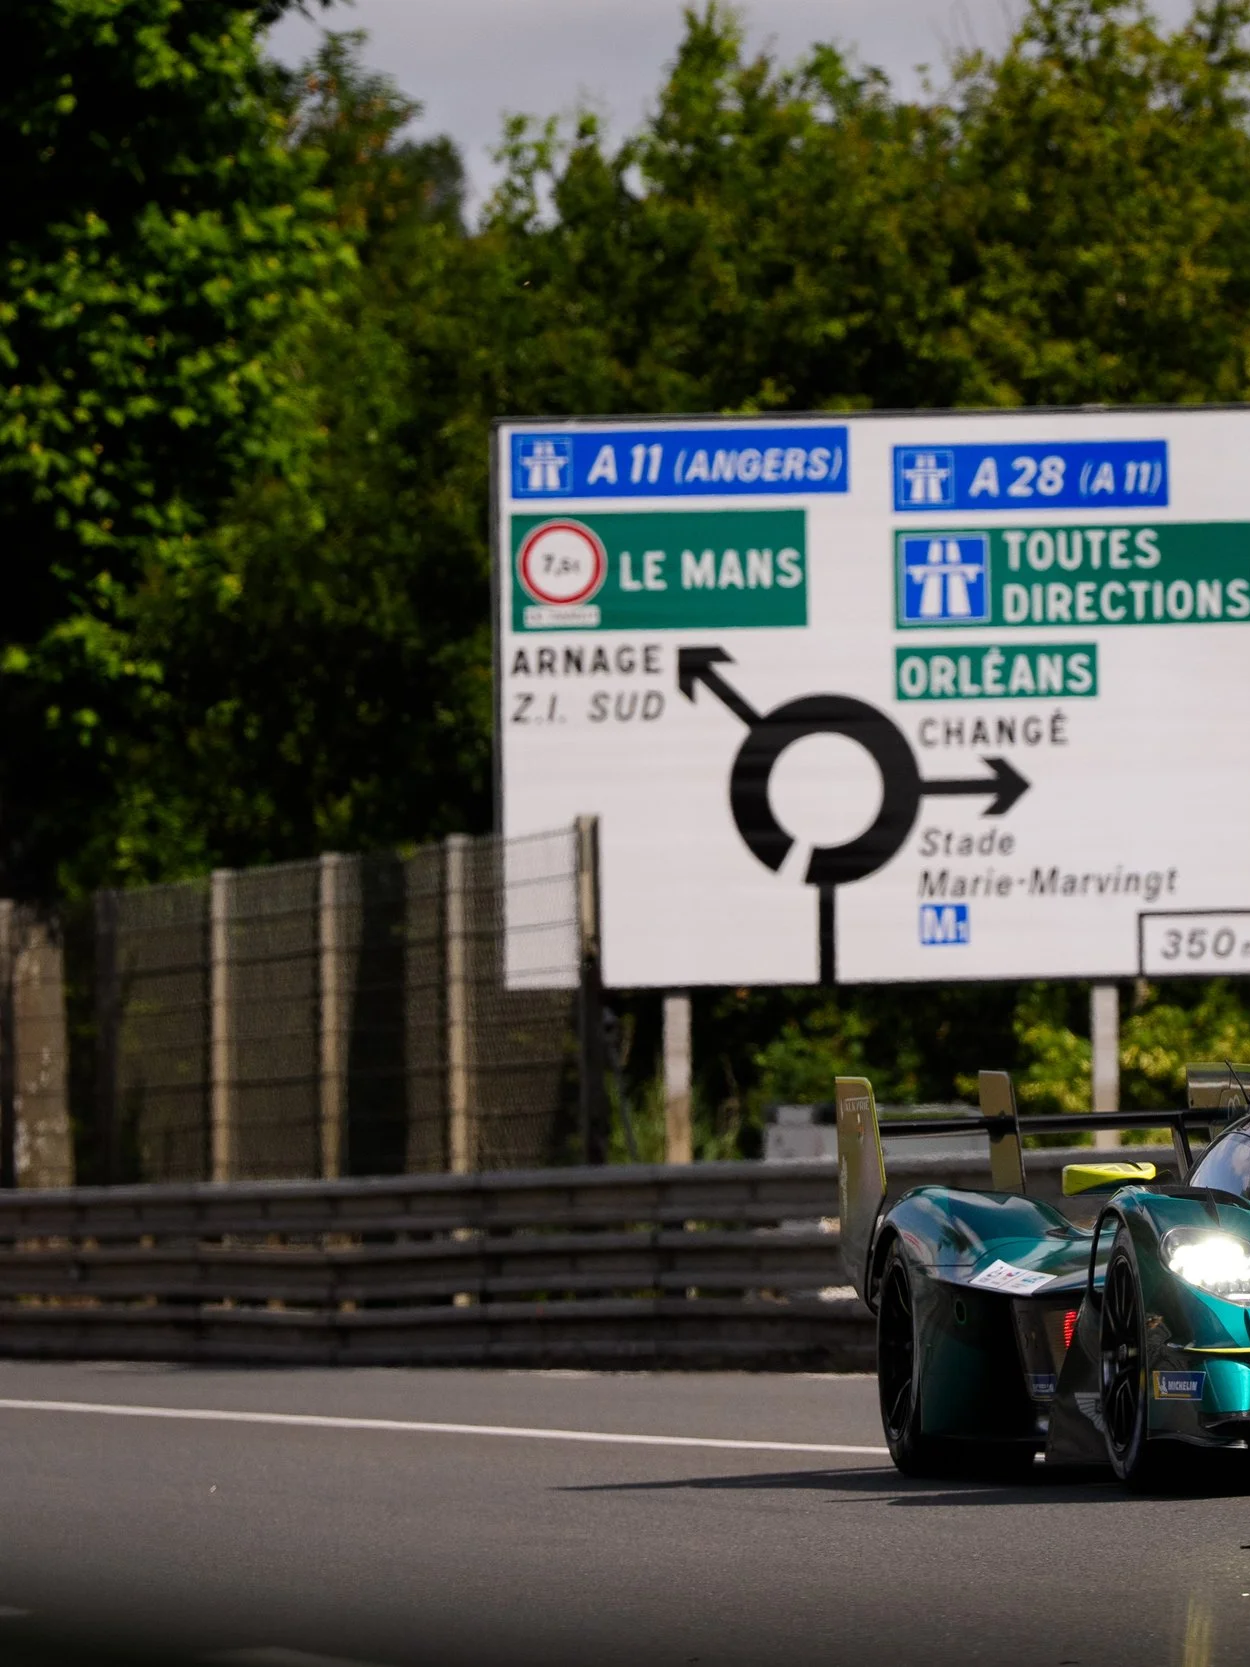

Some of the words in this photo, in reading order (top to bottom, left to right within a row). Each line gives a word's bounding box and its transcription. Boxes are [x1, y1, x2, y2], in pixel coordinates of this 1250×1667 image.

[587, 445, 618, 484] A
[630, 444, 663, 484] 11
[674, 447, 842, 484] (ANGERS)
[968, 457, 999, 498] A
[1007, 456, 1066, 498] 28
[1079, 461, 1115, 497] (A
[1124, 459, 1162, 496] 11)
[1003, 528, 1161, 571] TOUTES
[619, 551, 668, 591] LE
[681, 548, 802, 590] MANS
[511, 645, 663, 677] ARNAGE
[899, 647, 1093, 697] ORLÉANS
[511, 692, 566, 724] Z.I.
[587, 689, 666, 722] SUD
[918, 708, 1069, 748] CHANGÉ
[918, 826, 1016, 858] Stade
[918, 865, 1178, 902] Marie-Marvingt
[1161, 928, 1236, 961] 350
[1168, 1381, 1198, 1391] MICHELIN
